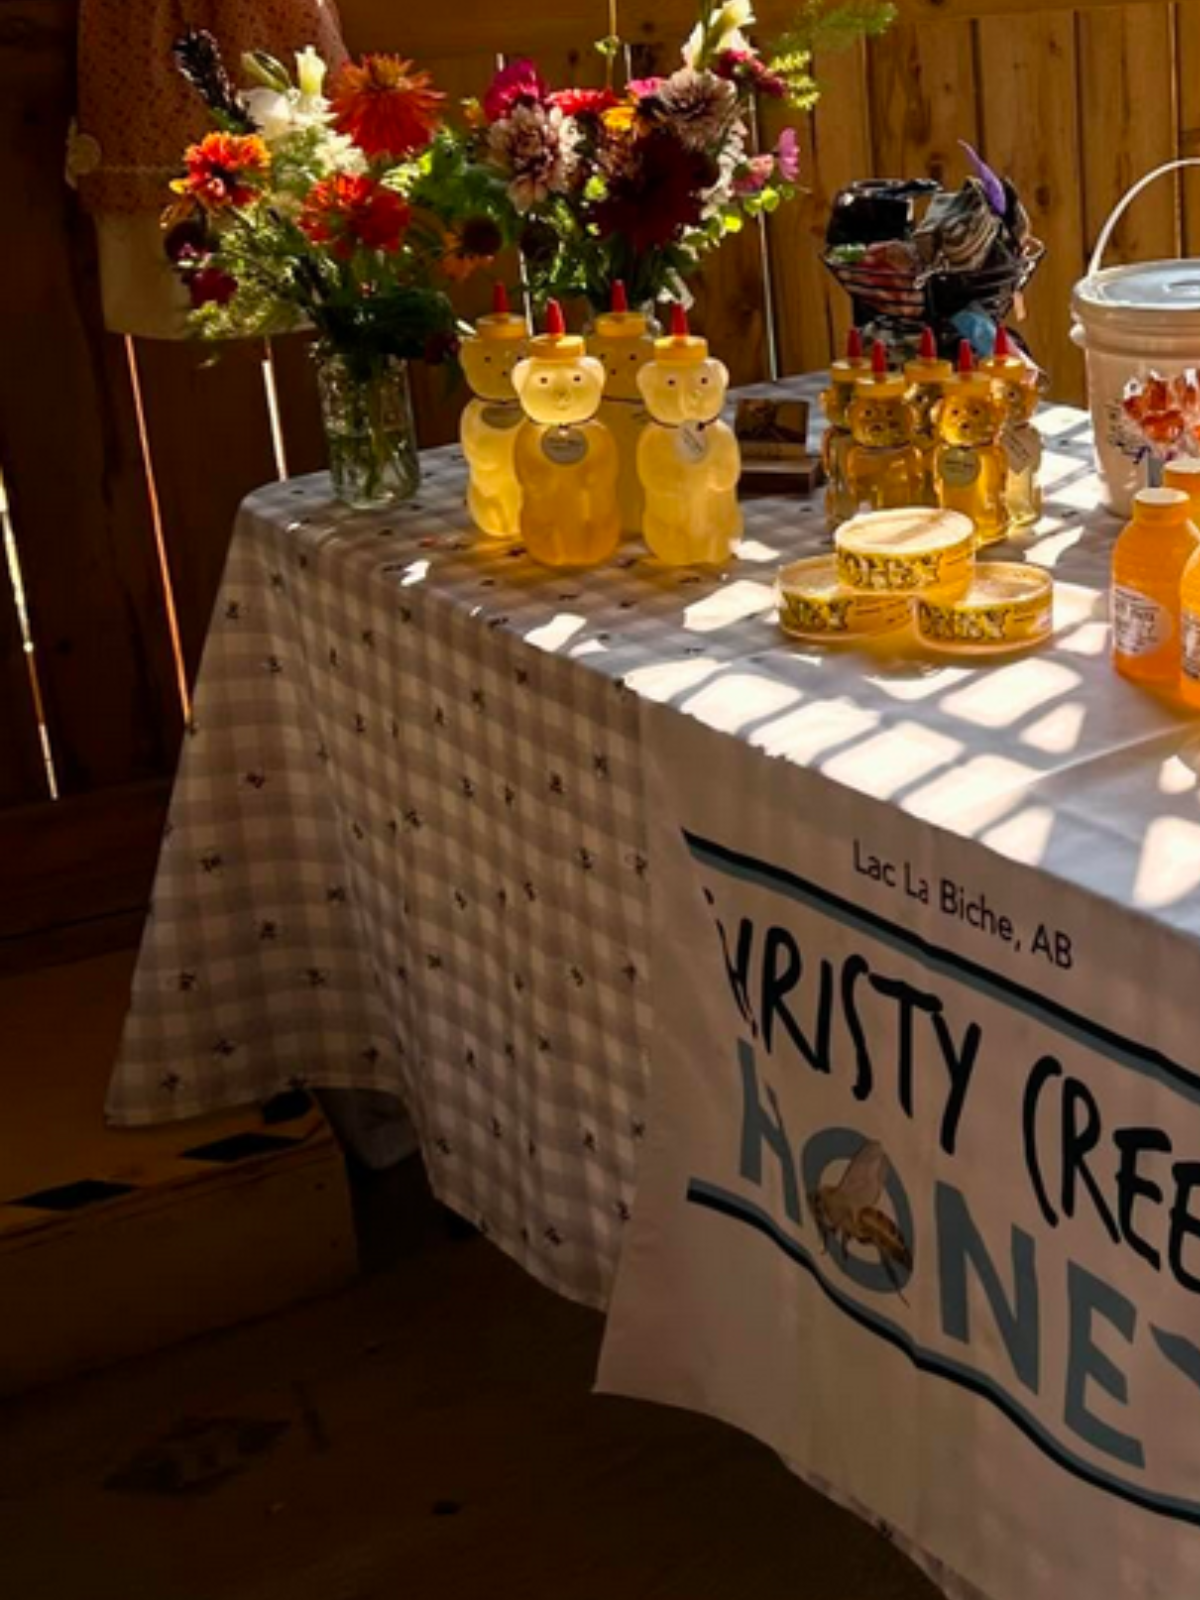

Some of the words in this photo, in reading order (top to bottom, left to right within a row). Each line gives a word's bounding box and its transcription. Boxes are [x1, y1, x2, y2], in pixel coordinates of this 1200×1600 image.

[853, 838, 897, 888] Lac
[904, 861, 929, 906] La
[940, 877, 1021, 952] Biche,
[1031, 923, 1074, 970] AB
